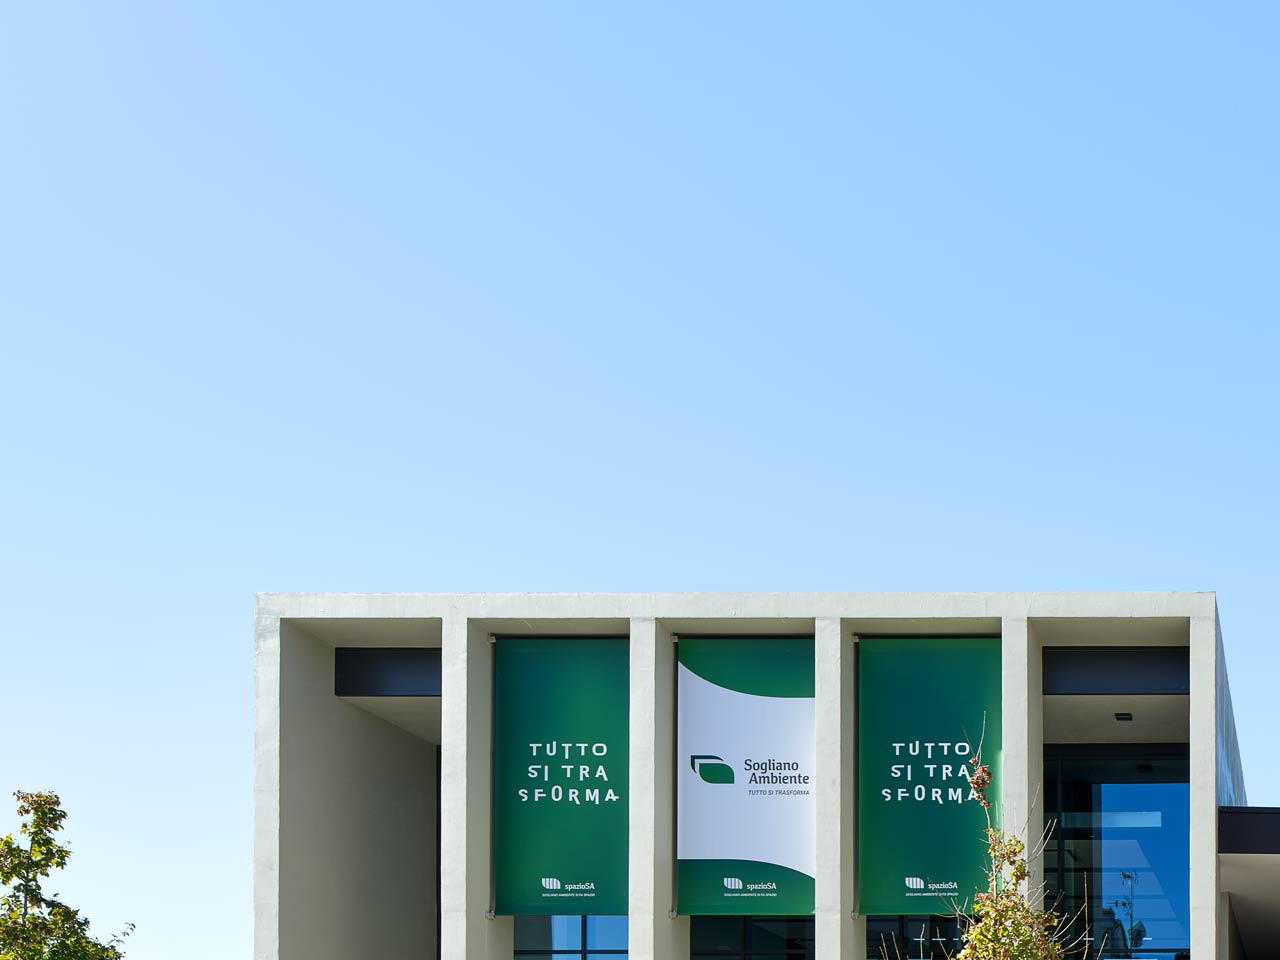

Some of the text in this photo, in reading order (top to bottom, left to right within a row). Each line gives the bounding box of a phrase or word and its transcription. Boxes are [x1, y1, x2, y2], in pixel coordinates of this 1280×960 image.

[529, 741, 608, 759] TUTTO
[892, 740, 970, 759] TUTTO
[528, 765, 608, 781] SI TRA
[744, 758, 799, 774] Sogliano
[891, 764, 970, 782] SI TRA
[748, 772, 810, 784] Ambiente
[518, 785, 619, 805] SFORMA
